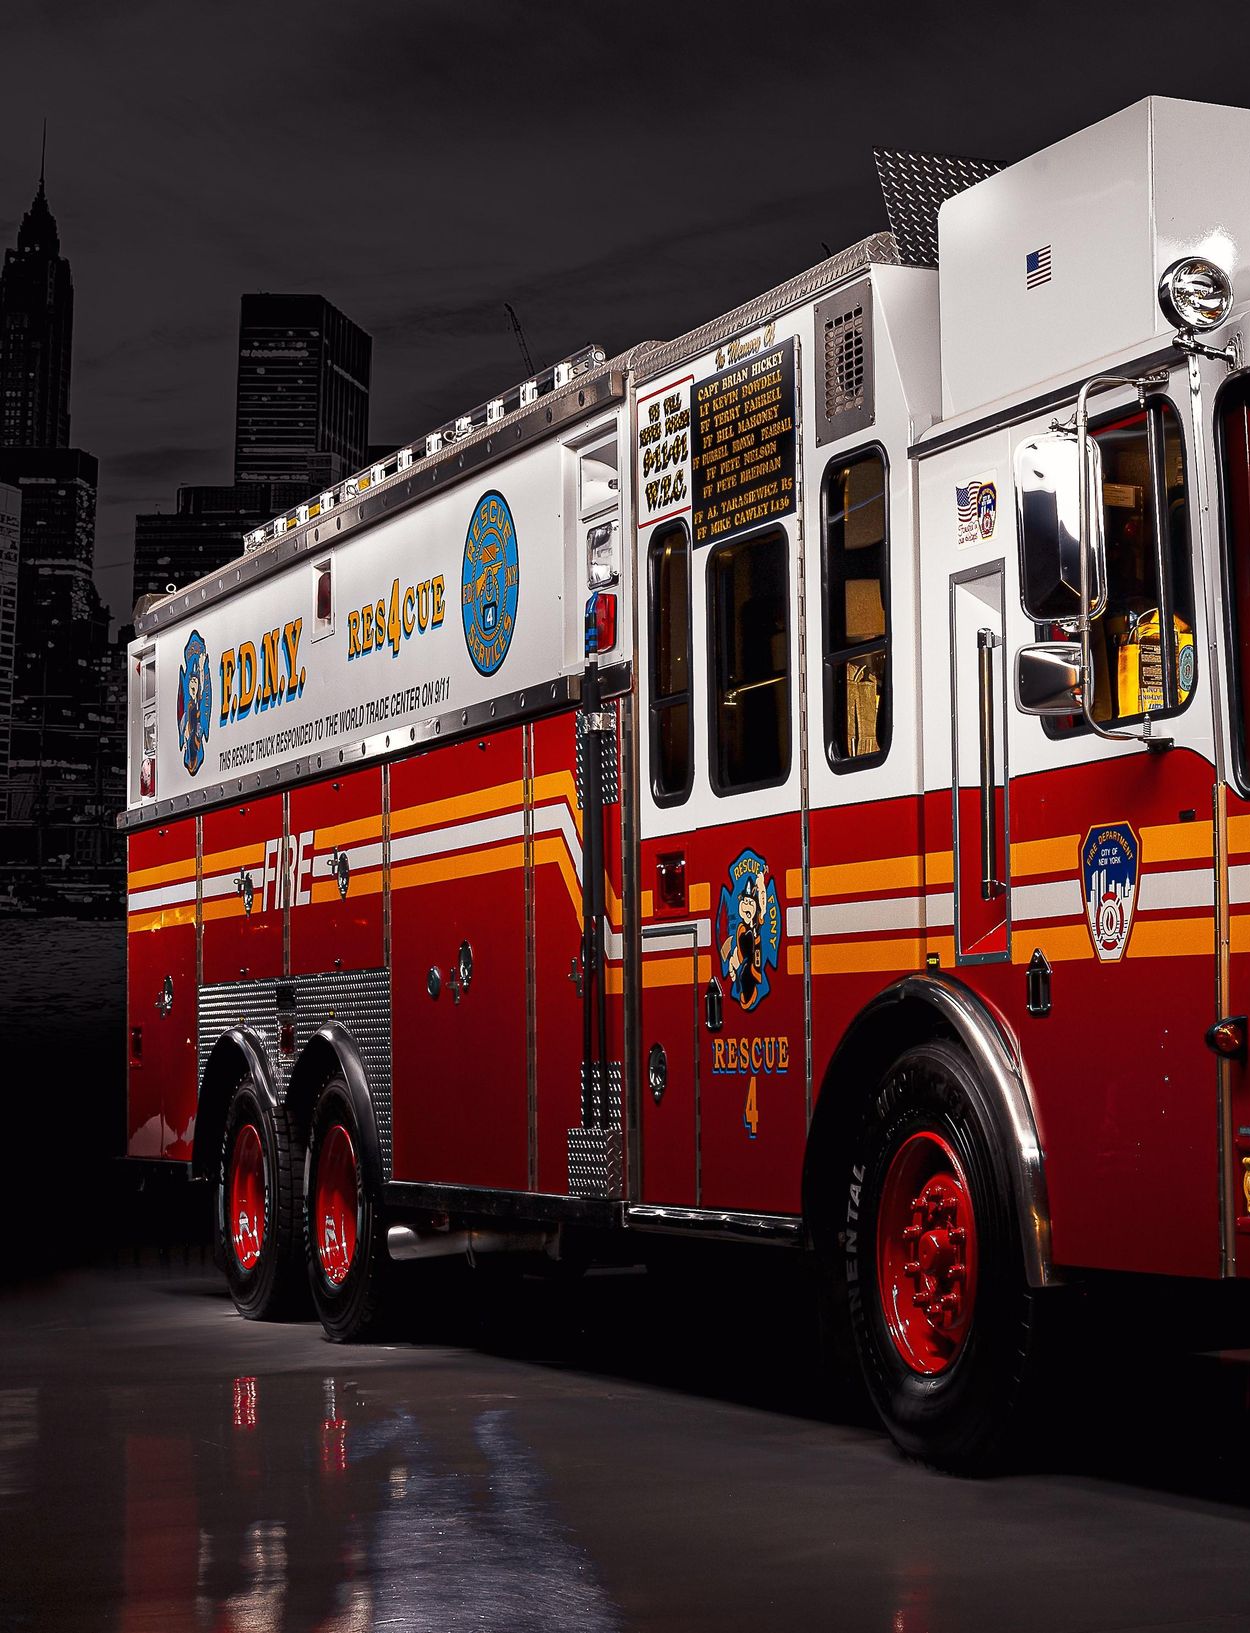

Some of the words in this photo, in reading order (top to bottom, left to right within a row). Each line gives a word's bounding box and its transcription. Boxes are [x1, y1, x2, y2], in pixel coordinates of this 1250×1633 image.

[698, 381, 719, 401] CAPT
[722, 367, 748, 390] BRIAN
[751, 350, 784, 376] HICKEY
[699, 402, 710, 417] LT
[712, 389, 739, 411] KEVIN
[741, 369, 782, 398] DOWDELL
[700, 419, 711, 434] FF
[713, 405, 741, 427] TERRY
[744, 387, 782, 414] FARRELL
[703, 434, 713, 449] FF
[716, 426, 735, 443] BILL
[737, 405, 779, 434] MAHONEY
[761, 417, 793, 441] PEARSALL
[703, 485, 713, 499] FF
[716, 474, 737, 493] PETE
[740, 456, 782, 483] BRENNAN
[706, 466, 717, 481] FF
[720, 456, 741, 475] PETE
[744, 441, 777, 465] NELSON
[694, 511, 704, 525] FF
[707, 505, 719, 520] AL
[721, 481, 779, 514] TARASIEWICZ
[781, 478, 793, 491] R5
[697, 526, 708, 540] FF
[710, 517, 732, 535] MIKE
[734, 502, 769, 526] CAWLEY
[466, 500, 513, 565] RESCUE
[468, 613, 512, 668] SERVICES
[486, 611, 494, 628] 4
[219, 617, 306, 726] F.D.N.Y.
[219, 752, 231, 772] THIS
[231, 742, 253, 768] RESCUE
[255, 736, 276, 761] TRUCK
[275, 722, 313, 754] RESPONDED
[314, 719, 324, 741] TO
[325, 713, 339, 738] THE
[339, 704, 364, 734] WORLD
[365, 696, 389, 725] TRADE
[390, 686, 421, 717] CENTER
[422, 681, 434, 708] ON
[435, 676, 450, 704] 9/11
[733, 858, 760, 881] RESCUE
[1086, 842, 1098, 866] FIRE
[1098, 830, 1134, 860] DEPARTMENT
[1098, 858, 1108, 866] NEW
[1109, 856, 1121, 865] YORK
[1101, 848, 1110, 857] CITY
[1111, 847, 1118, 856] OF
[263, 830, 314, 912] FIRE
[712, 1036, 789, 1074] RESCUE
[744, 1076, 759, 1139] 4
